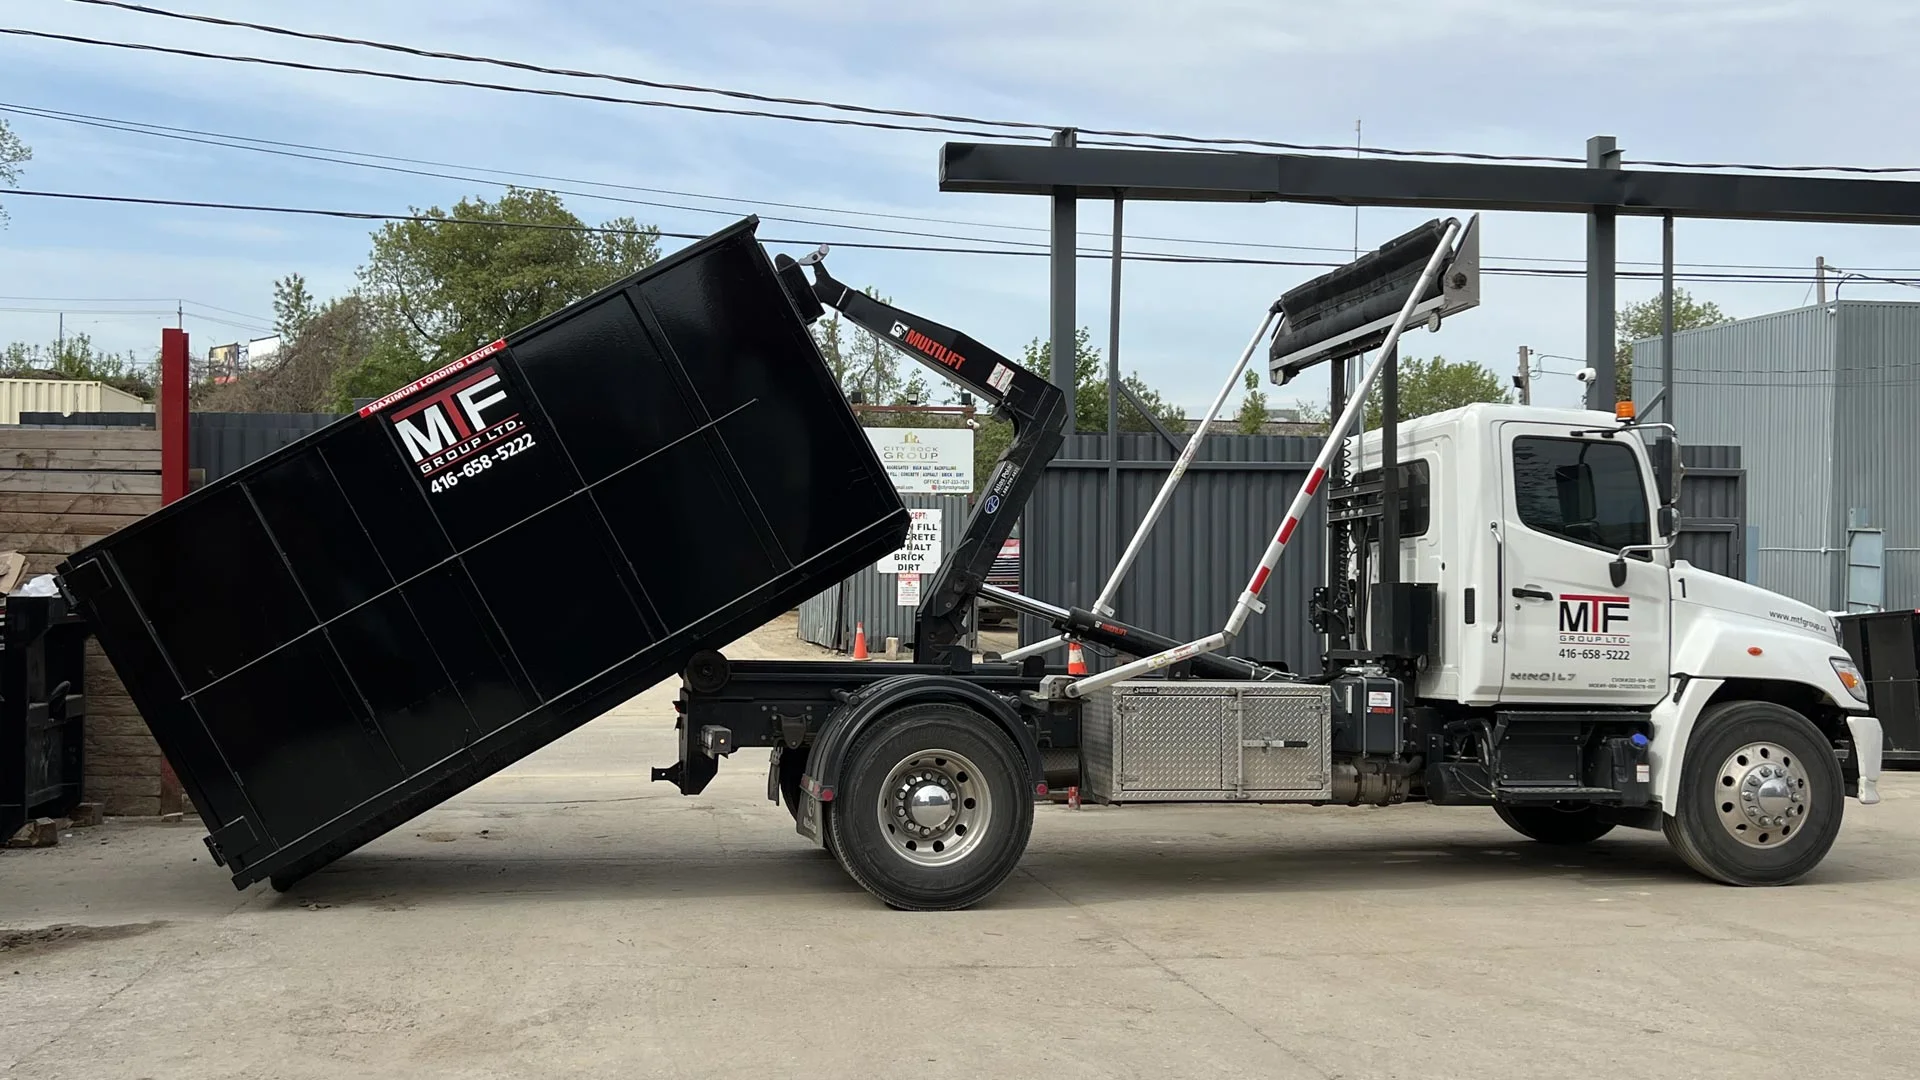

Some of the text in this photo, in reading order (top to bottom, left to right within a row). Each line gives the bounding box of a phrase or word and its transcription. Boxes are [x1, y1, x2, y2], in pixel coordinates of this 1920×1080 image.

[905, 329, 966, 370] MULTILIFT
[368, 345, 498, 413] MAXIMUM LOADING LEVEL
[391, 366, 507, 463] MTF
[420, 420, 524, 474] GROUP LTD.
[430, 433, 536, 493] 416-658-5222
[883, 452, 938, 460] GROUP
[917, 523, 937, 531] FILL
[905, 533, 936, 541] CRETE
[894, 553, 924, 561] BRICK
[897, 563, 920, 571] DIRT
[1677, 577, 1686, 599] 1
[1559, 594, 1630, 633] MTF
[1559, 635, 1630, 644] GROUP LTD.
[1558, 648, 1630, 661] 416-658-5222
